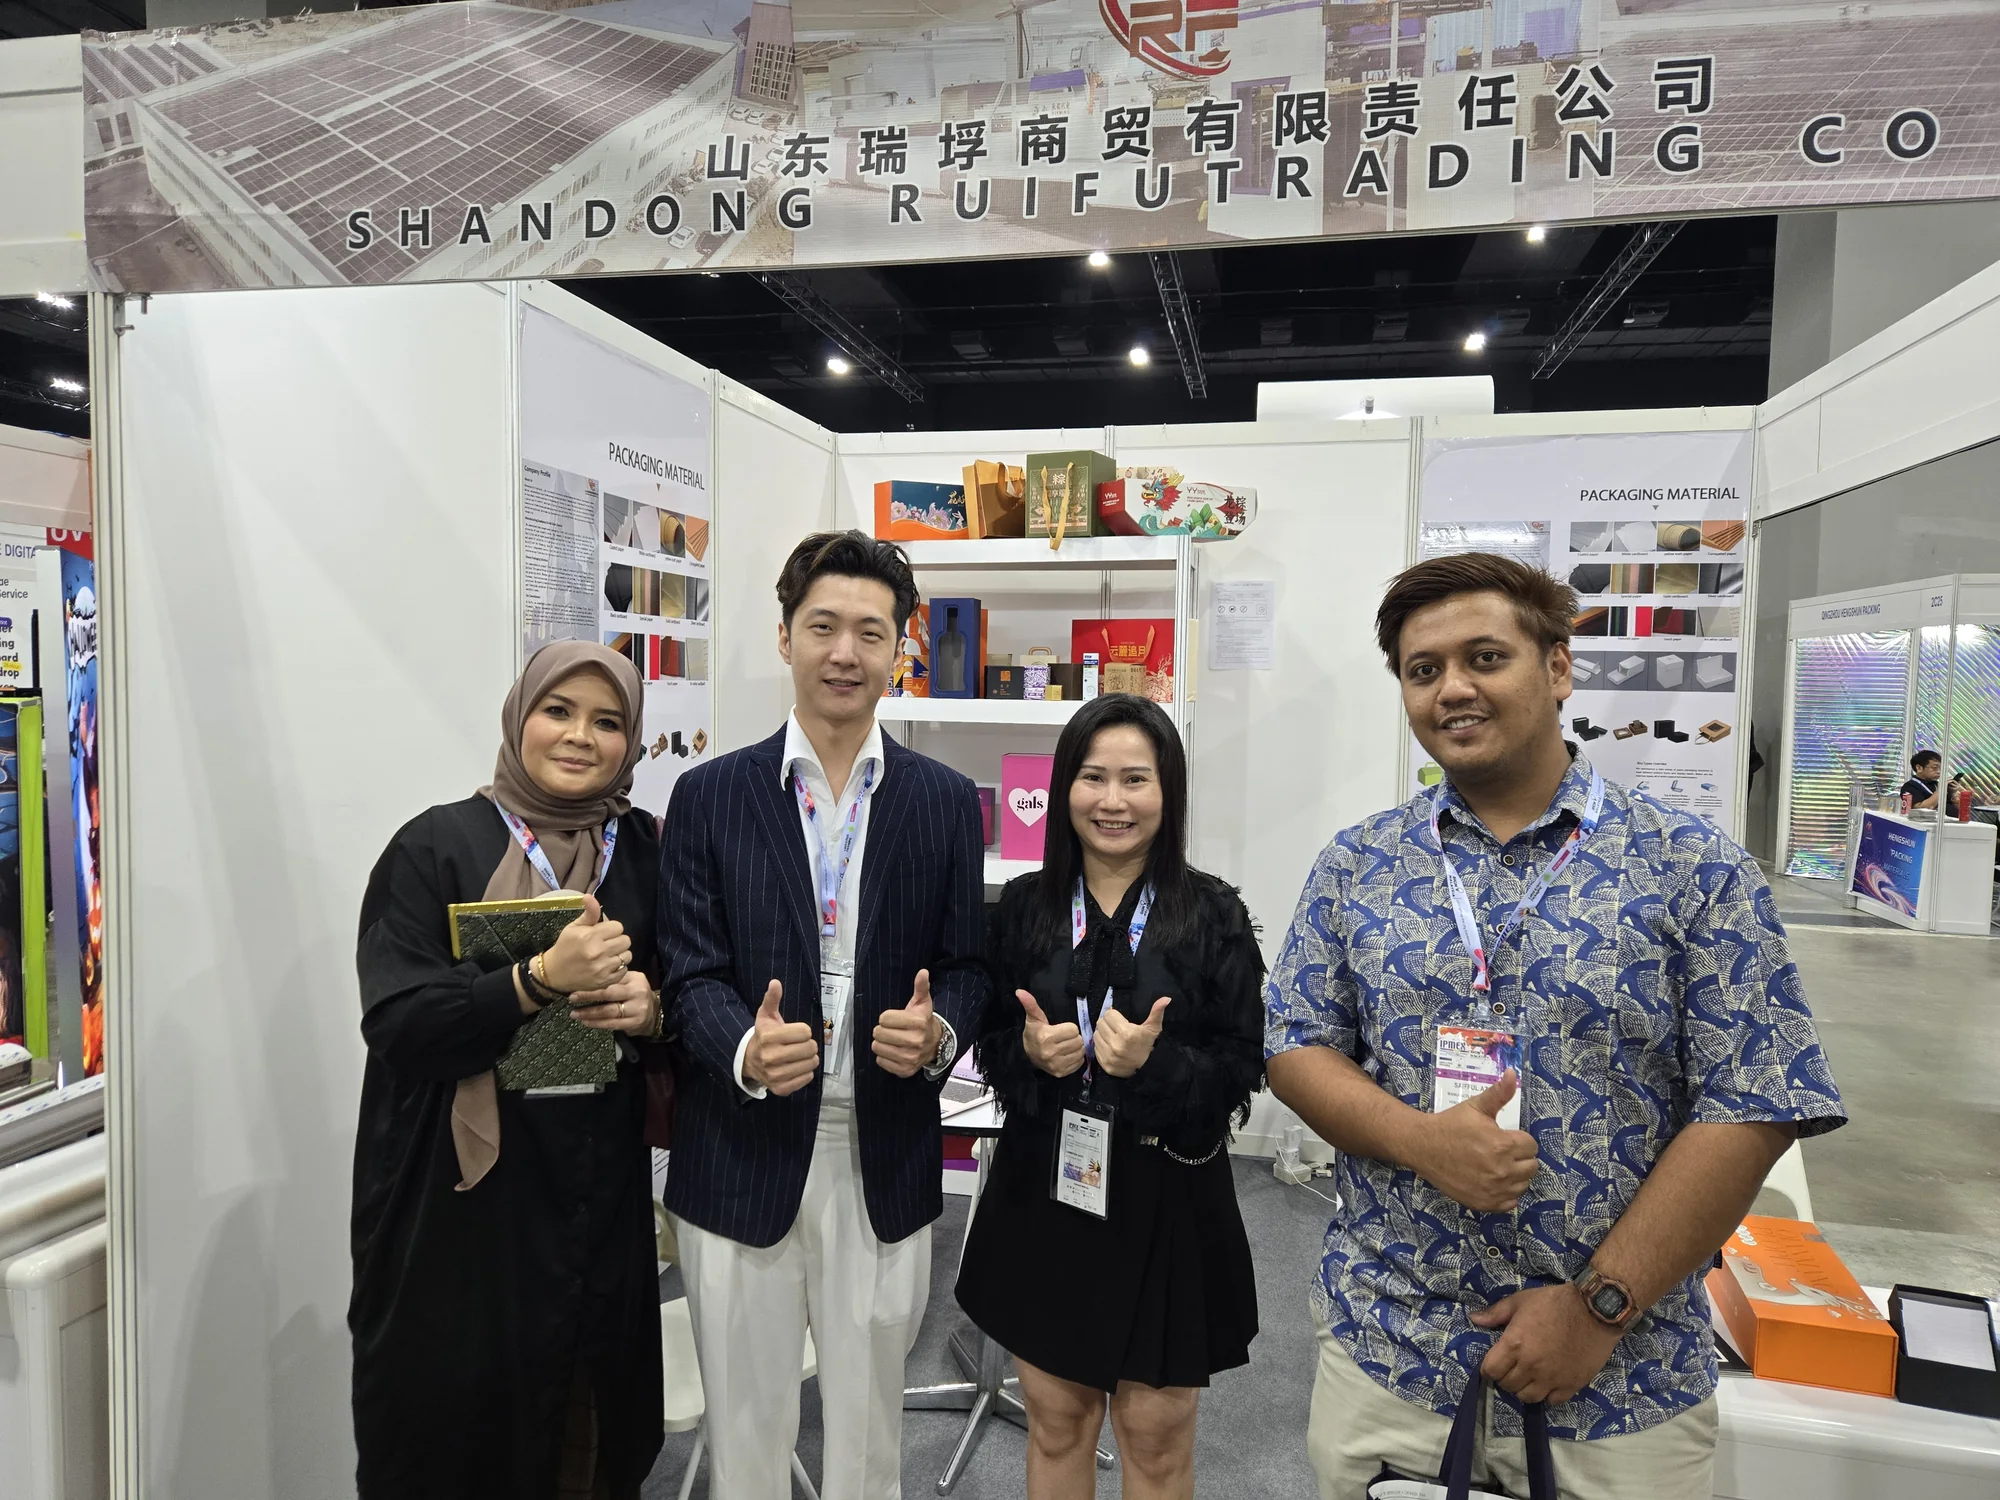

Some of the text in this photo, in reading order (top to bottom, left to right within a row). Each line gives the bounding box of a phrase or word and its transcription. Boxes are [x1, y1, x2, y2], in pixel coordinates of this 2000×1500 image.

[347, 189, 814, 250] SHANDONG
[1800, 109, 1941, 165] CO
[609, 442, 705, 490] PACKAGING MATERIAL
[1580, 488, 1740, 502] PACKAGING MATERIAL
[4, 544, 36, 559] DIGITA
[1862, 604, 1880, 616] PACKING
[1017, 796, 1044, 811] gals
[1888, 832, 1916, 848] HENGSHUN
[1891, 849, 1913, 864] PACKING
[1884, 863, 1910, 880] MATERIALS
